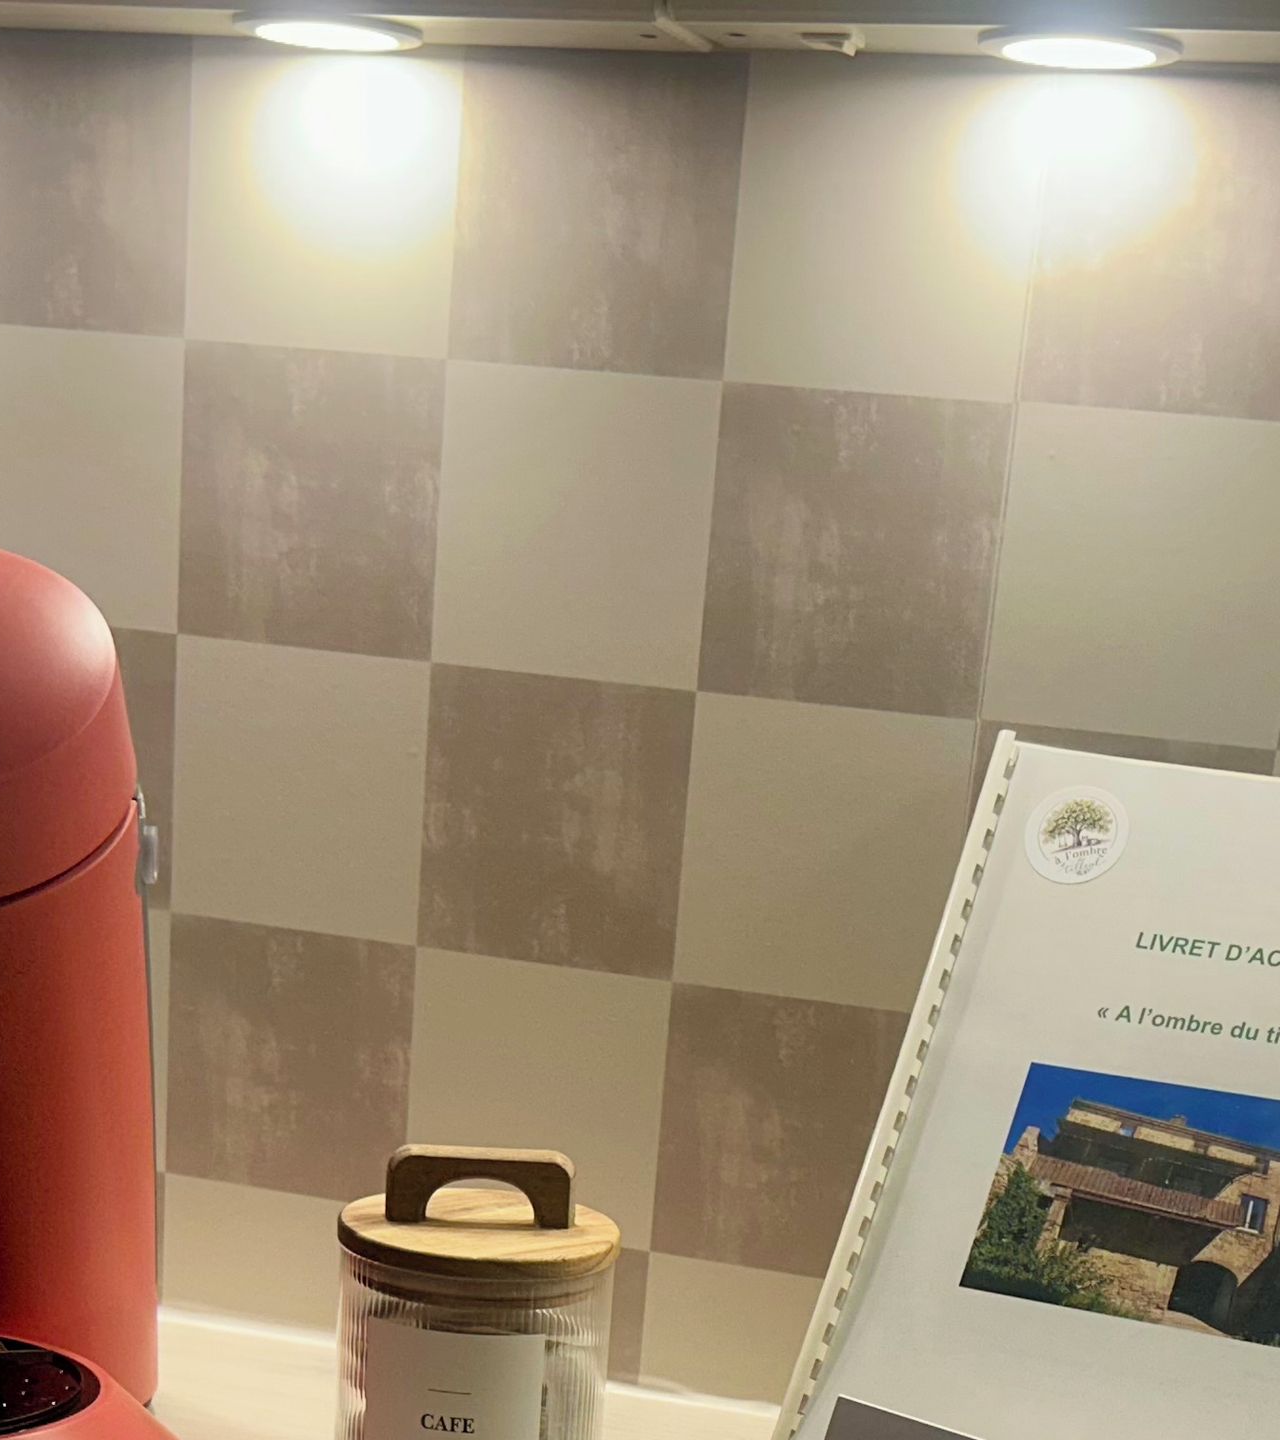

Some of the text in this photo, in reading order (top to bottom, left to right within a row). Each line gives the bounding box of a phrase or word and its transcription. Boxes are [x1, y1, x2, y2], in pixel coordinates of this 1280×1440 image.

[1135, 931, 1221, 960] LIVRET
[1115, 1005, 1132, 1023] A
[1138, 1008, 1223, 1036] l'ombre
[1230, 1021, 1259, 1042] du
[420, 1413, 476, 1435] CAFE
